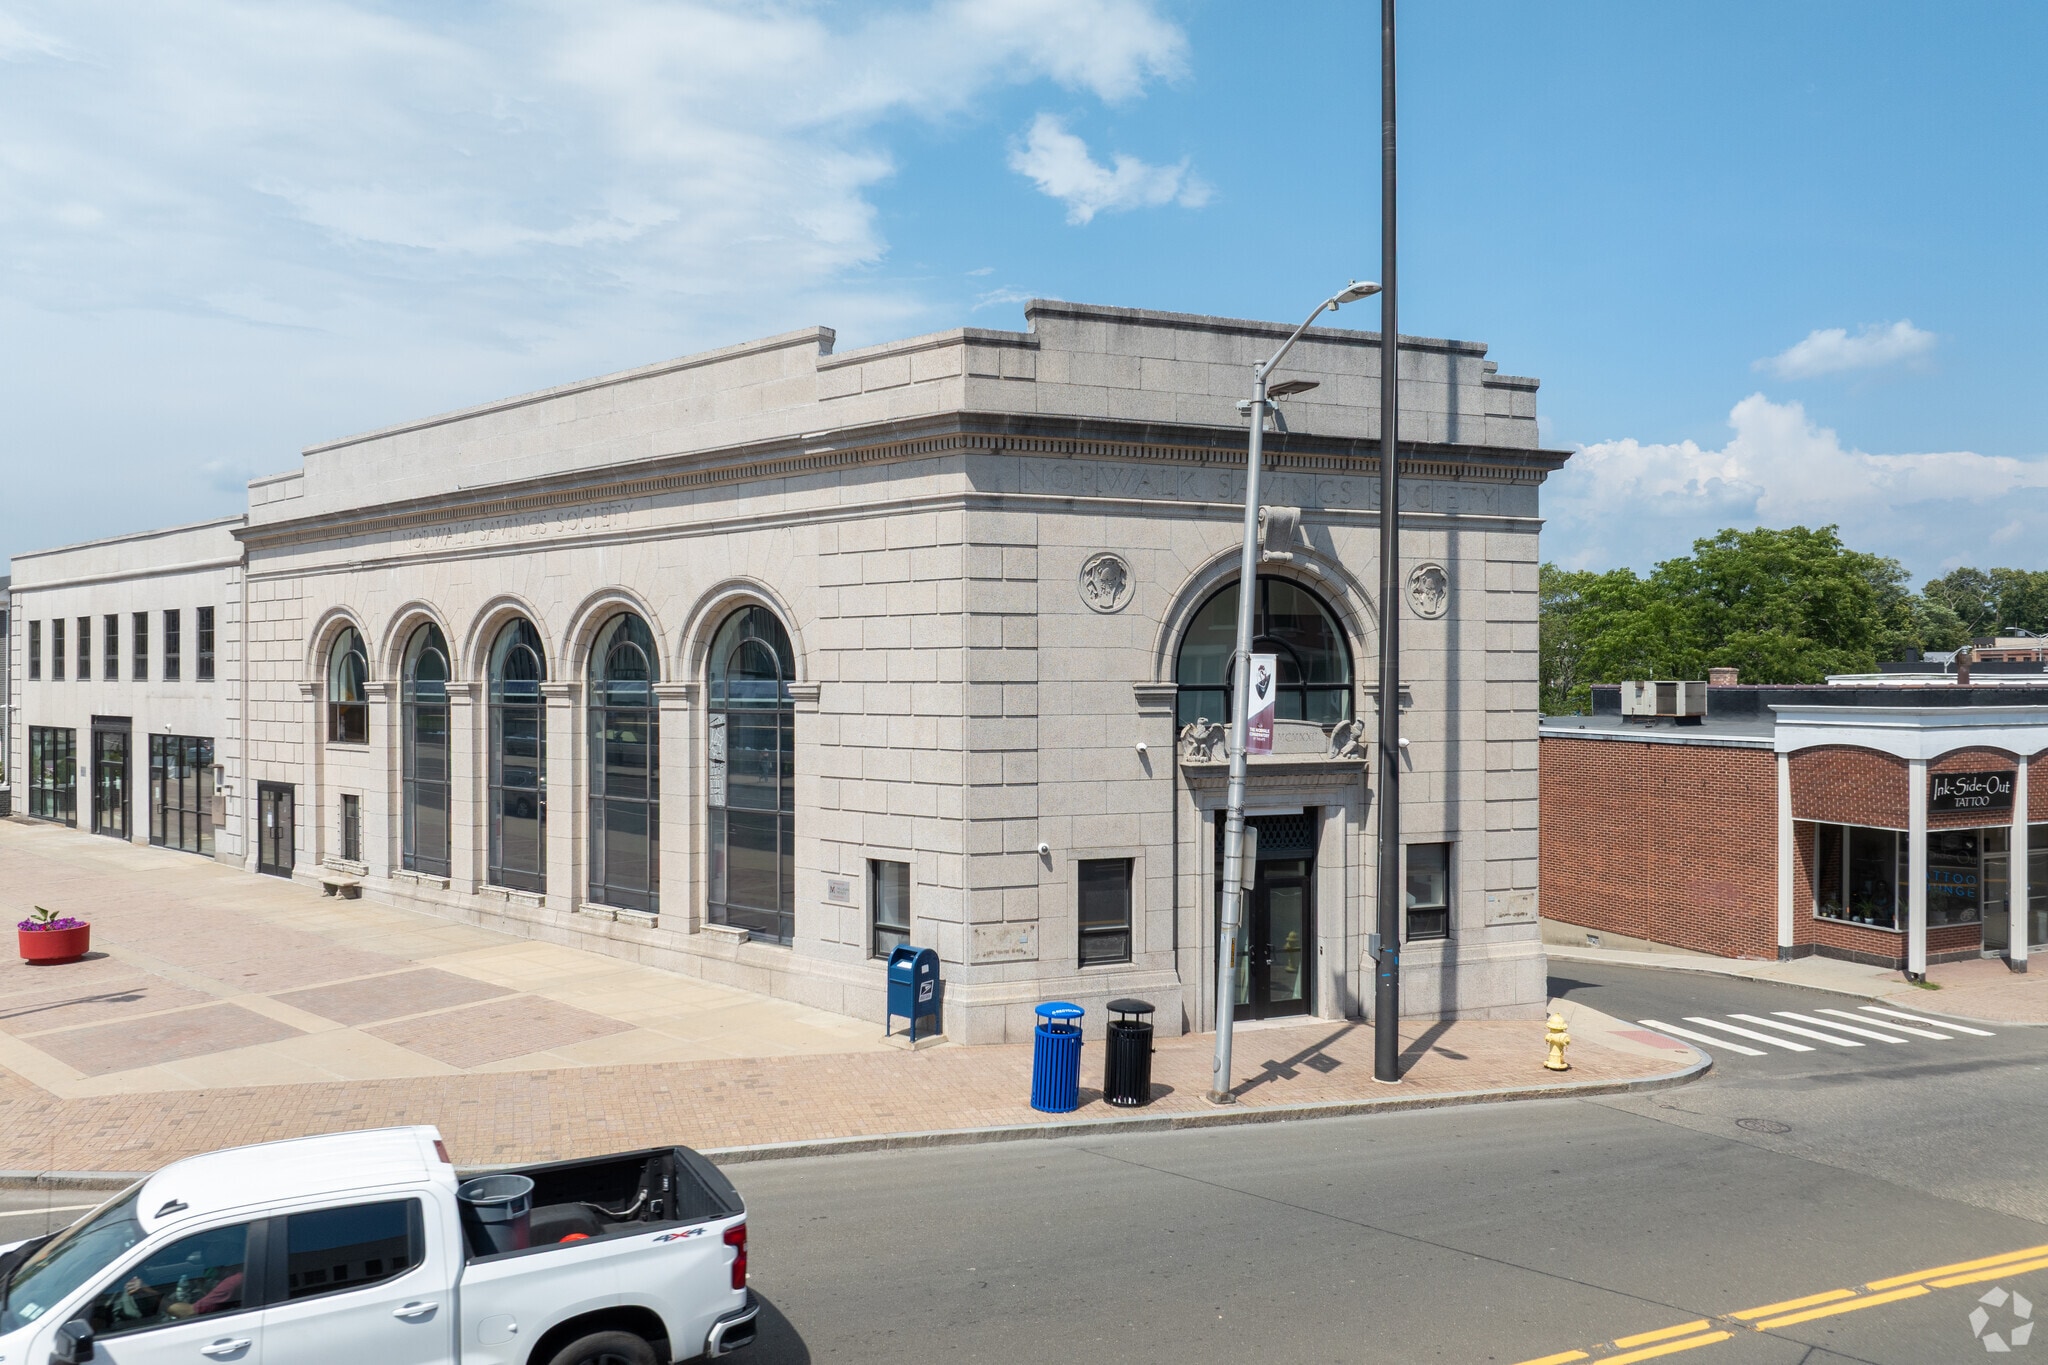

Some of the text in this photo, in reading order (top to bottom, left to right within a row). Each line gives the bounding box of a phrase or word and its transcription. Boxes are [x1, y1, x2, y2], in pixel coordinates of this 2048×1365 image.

[1023, 462, 1201, 498] NORWALK
[1217, 472, 1354, 505] SAVINGS
[402, 503, 635, 551] NORWALK SAVINGS SOCIETY
[1933, 776, 2011, 801] Ink-Side-Out
[1954, 796, 1990, 807] TATTOO
